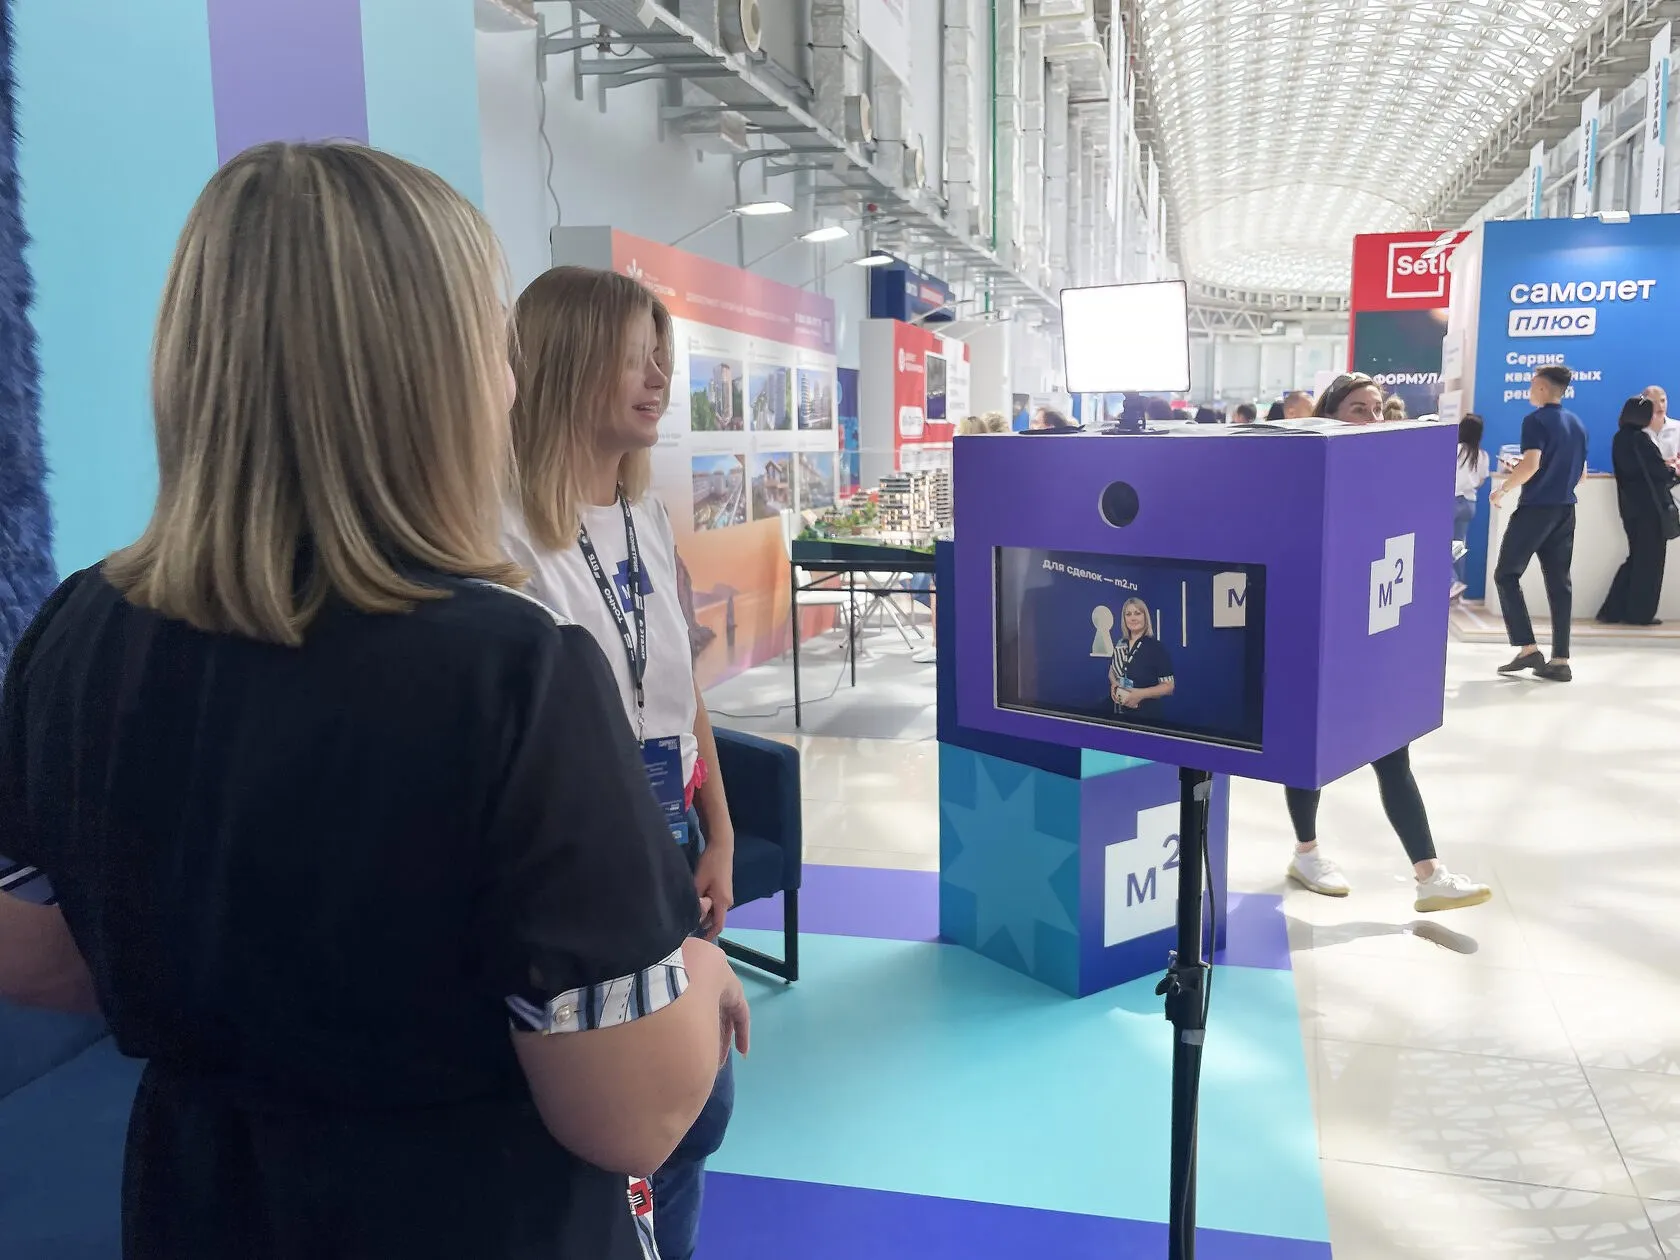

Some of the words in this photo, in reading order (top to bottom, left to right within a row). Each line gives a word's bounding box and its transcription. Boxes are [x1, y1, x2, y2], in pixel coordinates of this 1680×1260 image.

[1510, 280, 1656, 304] самолет
[1515, 315, 1590, 331] плюс
[1505, 351, 1565, 368] Сервис
[1504, 371, 1602, 382] кваных
[1066, 566, 1102, 582] сделок
[604, 588, 624, 624] ТОЧНО
